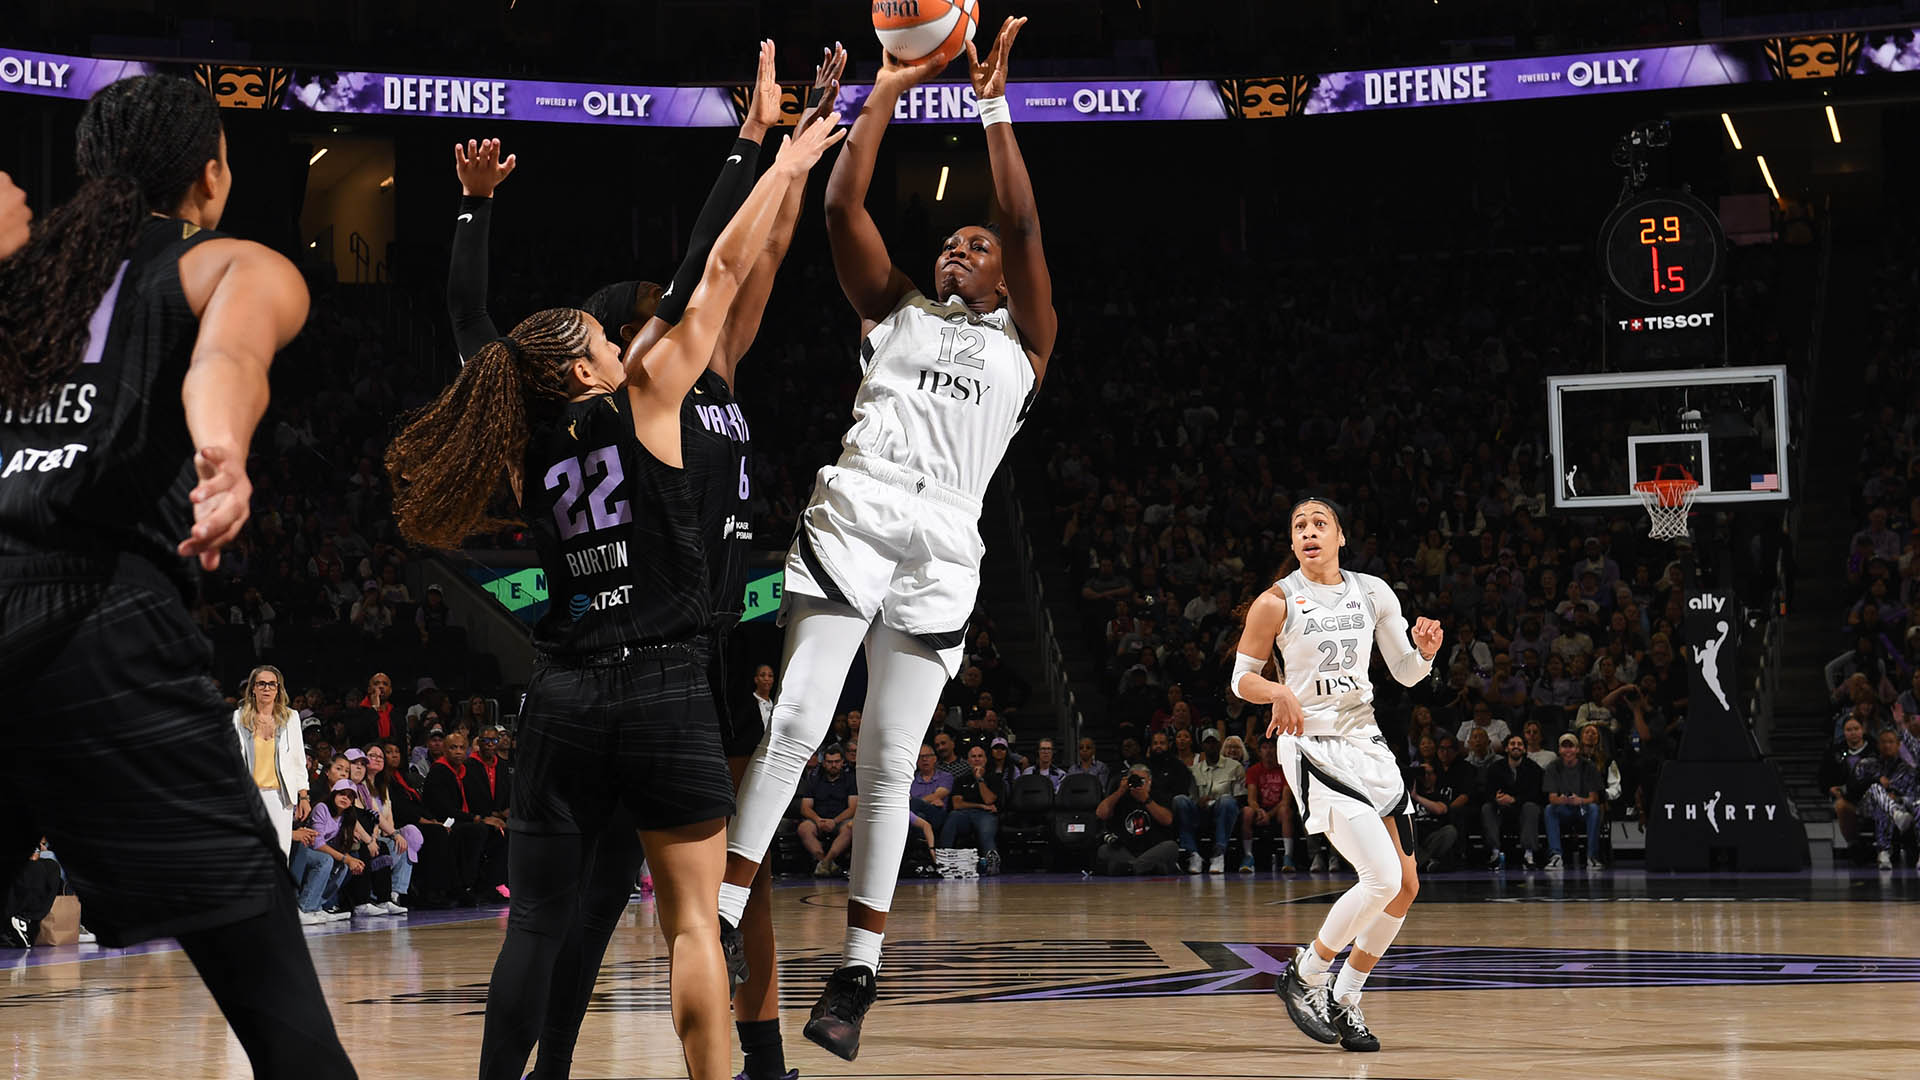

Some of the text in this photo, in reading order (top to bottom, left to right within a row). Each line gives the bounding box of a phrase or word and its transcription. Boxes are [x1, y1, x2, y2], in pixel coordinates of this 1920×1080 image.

[872, 0, 921, 19] Wilso
[1364, 64, 1487, 106] DEFENSE
[1517, 72, 1549, 83] POWERED
[1551, 71, 1561, 81] BY
[383, 76, 506, 115] DEFENSE
[535, 96, 566, 107] POWERED
[567, 98, 577, 107] BY
[894, 86, 979, 119] EFENS
[1025, 97, 1056, 107] POWERED
[1057, 97, 1067, 106] BY
[1639, 216, 1680, 244] 2.9
[1651, 245, 1685, 294] 1.5
[1644, 312, 1715, 330] TISSOT
[936, 326, 986, 371] 12
[917, 369, 991, 406] IPSY
[1, 443, 88, 479] AT&T
[738, 455, 750, 500] 6
[543, 444, 633, 541] 22
[565, 540, 629, 578] BURTON
[588, 584, 634, 611] AT&T
[1345, 600, 1361, 610] ally
[1688, 593, 1726, 613] ally
[1303, 613, 1366, 635] ACES
[1317, 638, 1358, 672] 23
